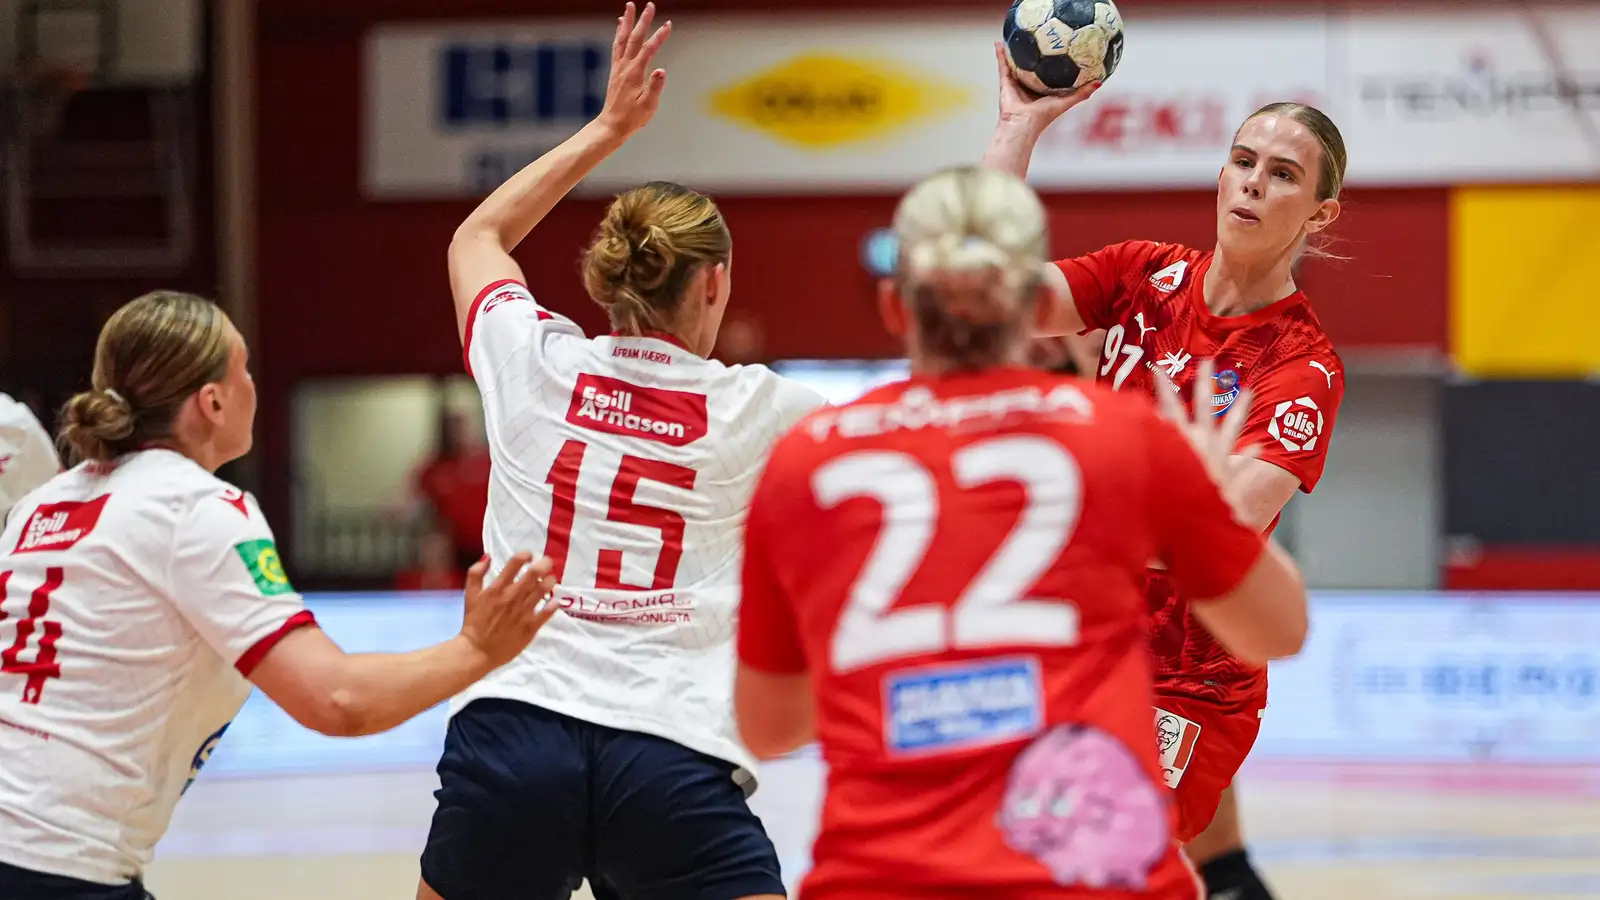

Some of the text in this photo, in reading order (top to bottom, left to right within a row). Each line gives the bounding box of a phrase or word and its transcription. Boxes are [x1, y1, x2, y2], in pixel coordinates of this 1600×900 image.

[1100, 323, 1144, 392] 97
[576, 398, 685, 438] Arnason
[582, 386, 633, 413] Egill
[1210, 393, 1235, 405] AUKAR
[1283, 411, 1315, 436] olis
[543, 439, 698, 591] 15
[811, 434, 1084, 674] 22
[0, 566, 64, 705] 4
